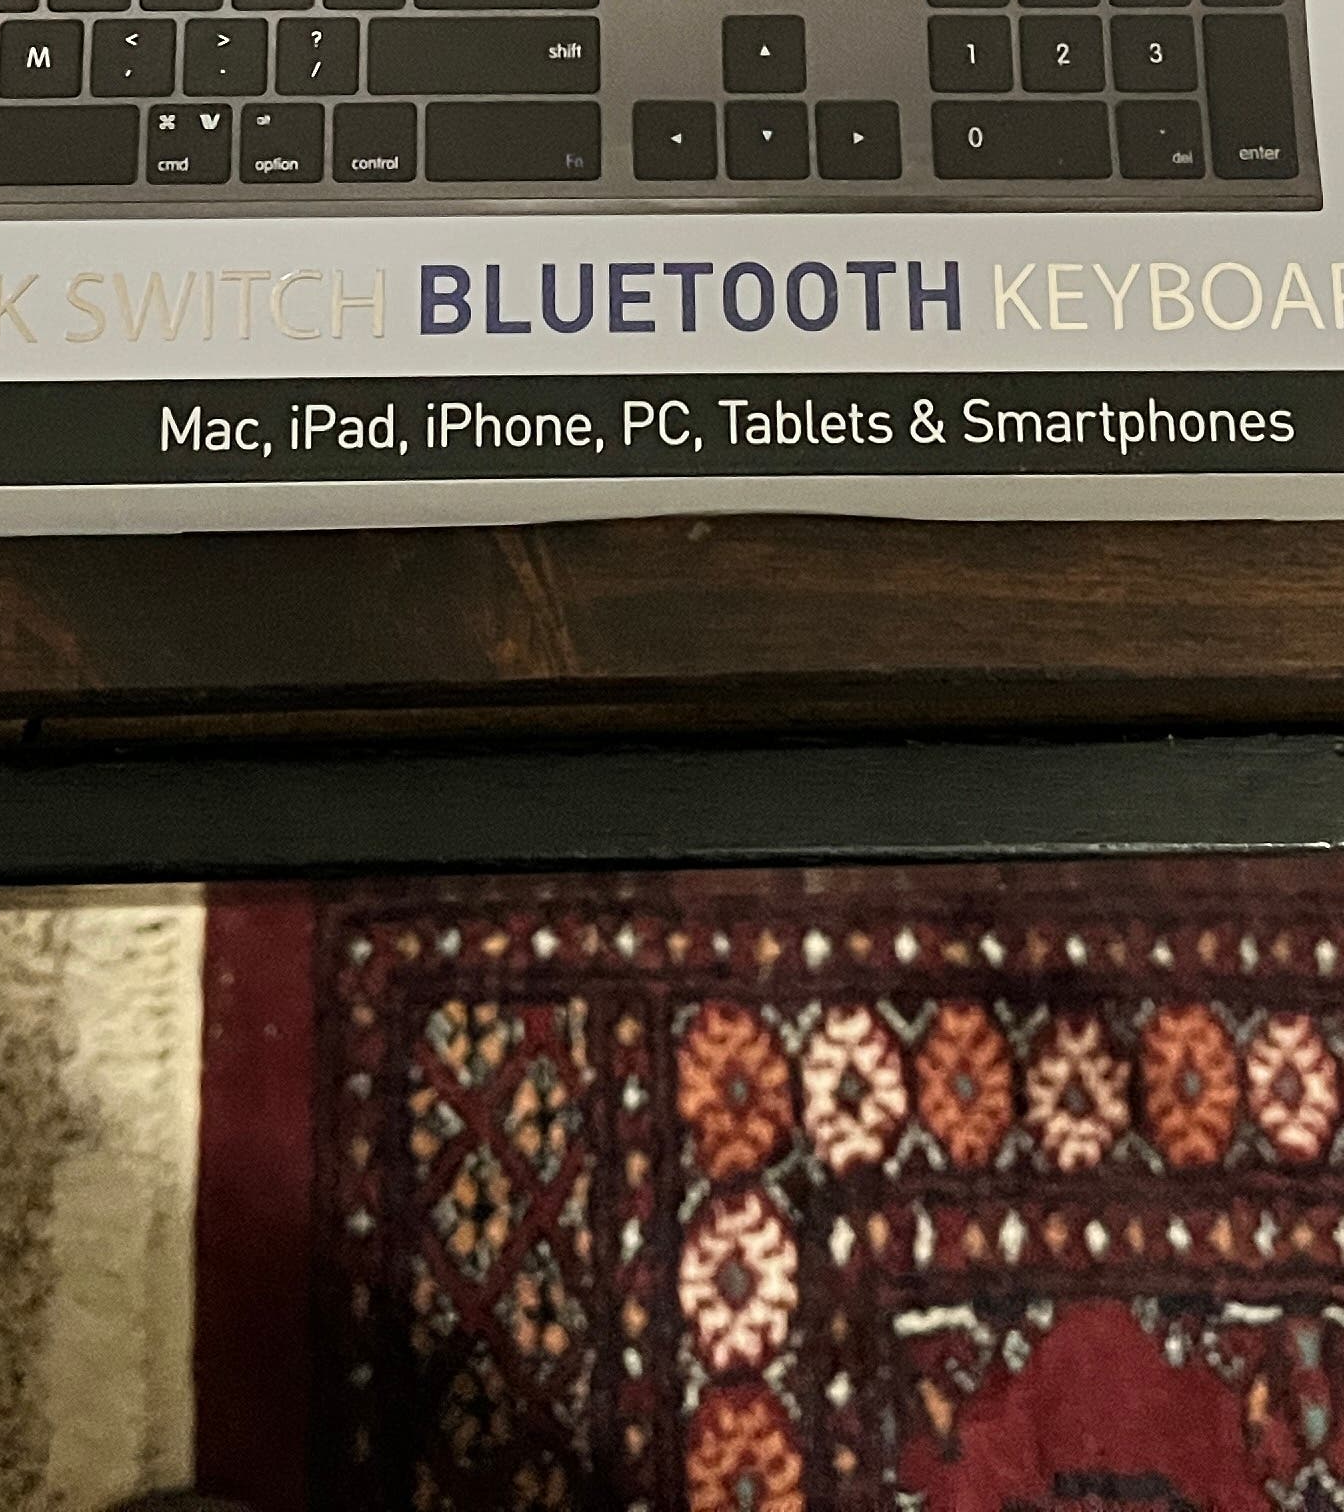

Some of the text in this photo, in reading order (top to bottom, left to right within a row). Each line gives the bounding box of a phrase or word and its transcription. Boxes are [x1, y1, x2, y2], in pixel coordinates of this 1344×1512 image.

[311, 30, 322, 48] ?
[26, 46, 51, 68] M
[548, 42, 582, 59] shift
[966, 43, 976, 64] 1
[1056, 42, 1071, 66] 2
[1149, 42, 1163, 64] 3
[1239, 145, 1281, 161] enter
[157, 157, 189, 172] cmd
[254, 157, 299, 174] option
[351, 156, 399, 170] control
[65, 268, 385, 345] SWITCH
[420, 261, 961, 335] BLUETOOTH
[161, 397, 1295, 458] Mac, iPad, iPhone, PC, Tablets & Smartphones
